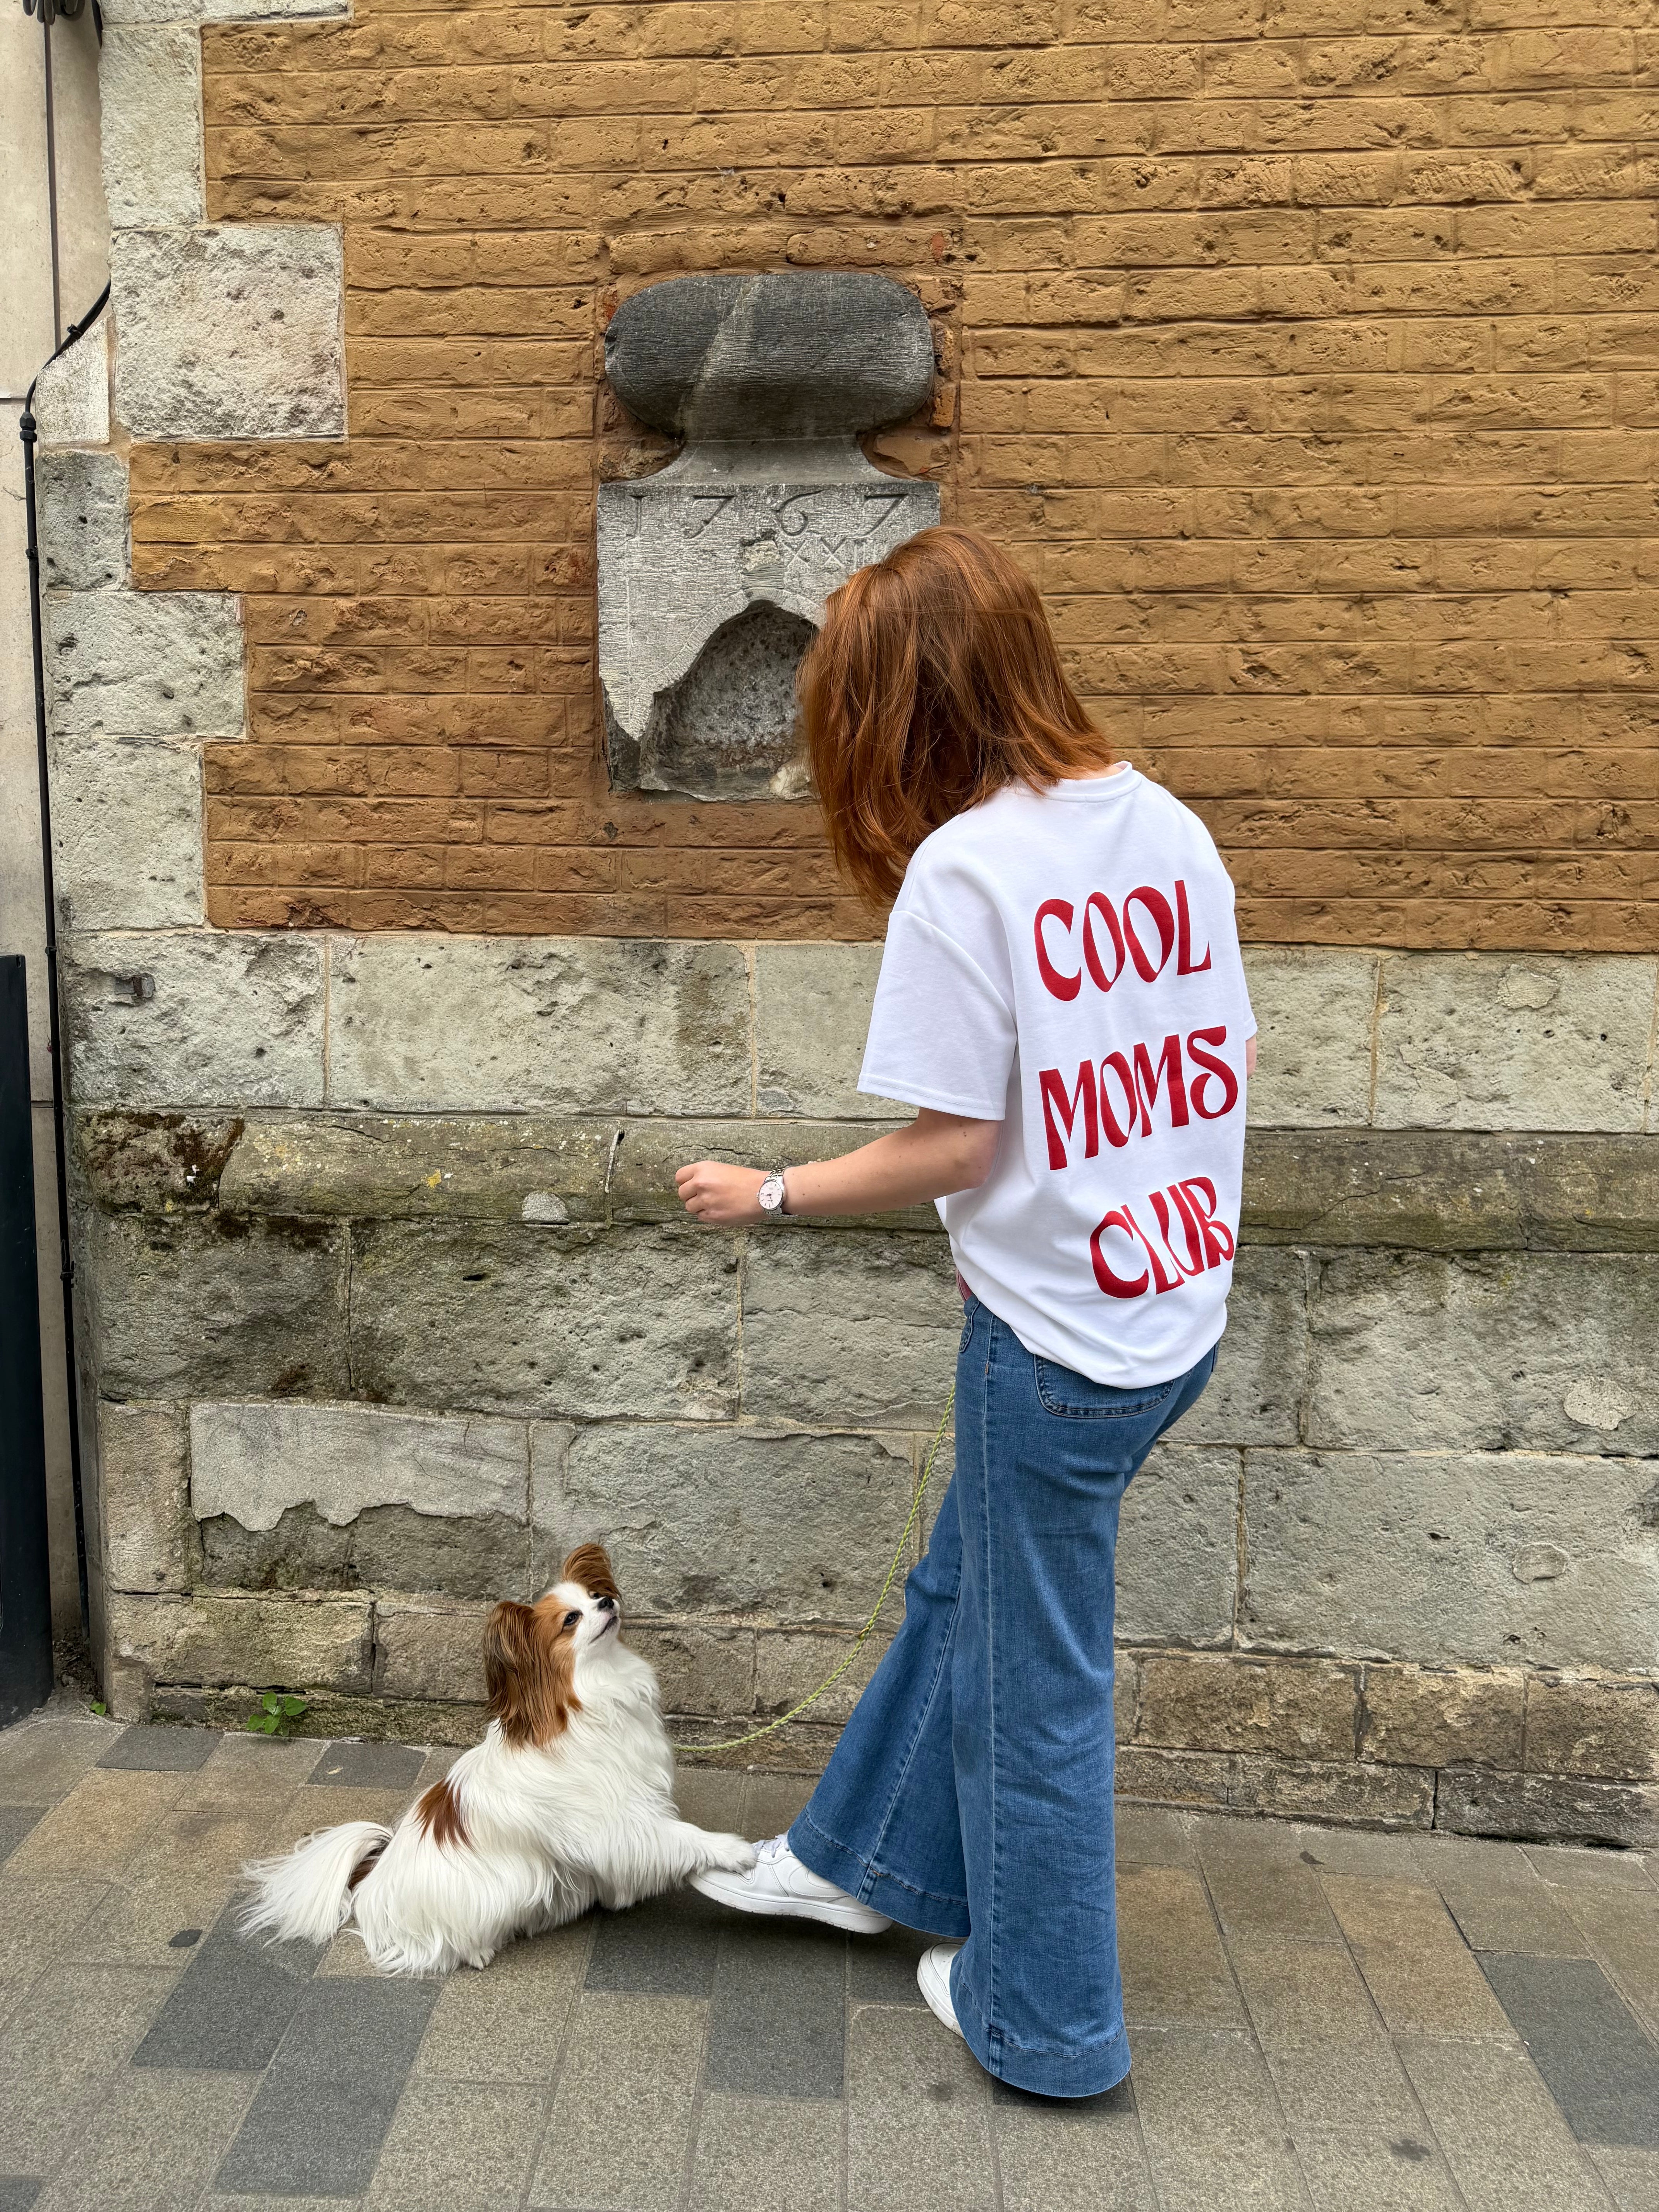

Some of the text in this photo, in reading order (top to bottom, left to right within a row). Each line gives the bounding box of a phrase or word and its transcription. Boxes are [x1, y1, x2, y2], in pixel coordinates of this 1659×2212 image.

[628, 489, 911, 540] 1767
[1034, 879, 1212, 1002] COOL
[1038, 1025, 1238, 1171] MOMS
[1089, 1176, 1235, 1299] CLUB
